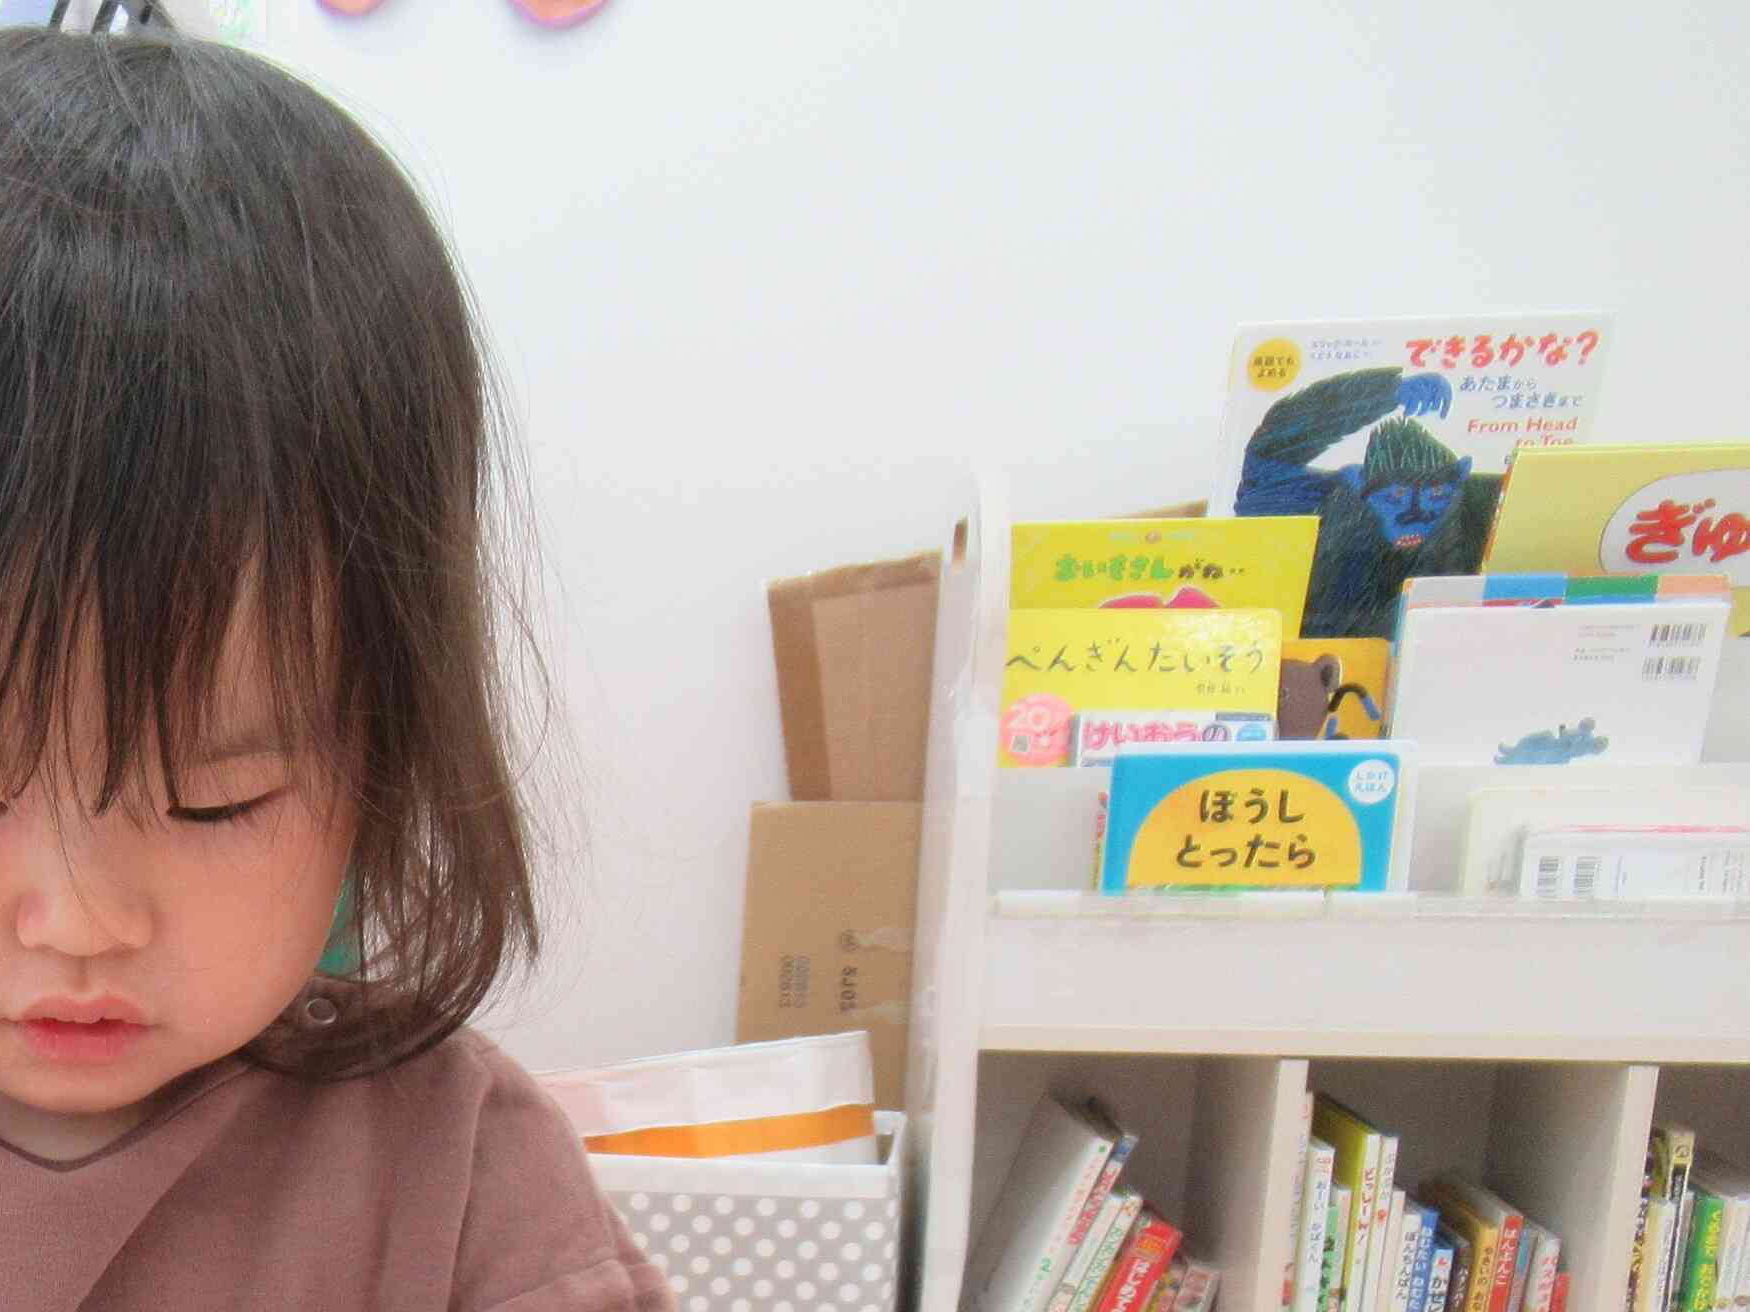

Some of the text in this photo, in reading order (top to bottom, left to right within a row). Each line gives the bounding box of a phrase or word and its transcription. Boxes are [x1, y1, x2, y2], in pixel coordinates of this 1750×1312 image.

[1467, 417, 1578, 432] From Head
[1175, 834, 1316, 868] とったら
